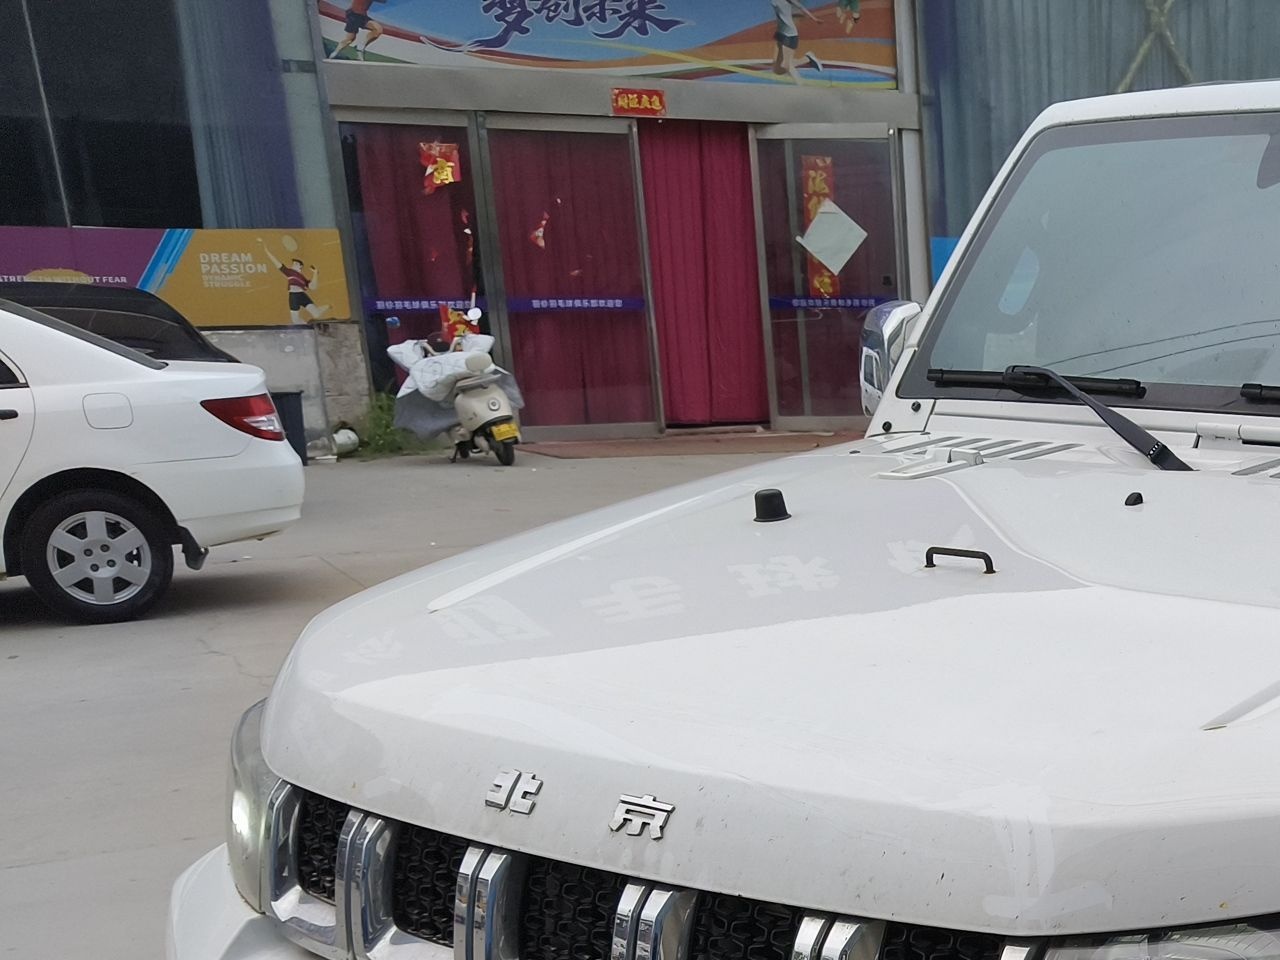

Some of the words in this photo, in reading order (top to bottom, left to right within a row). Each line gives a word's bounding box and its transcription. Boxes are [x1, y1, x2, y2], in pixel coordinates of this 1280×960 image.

[200, 253, 253, 263] DREAM
[201, 264, 268, 273] PASSION
[102, 276, 128, 284] FEAR
[485, 769, 675, 840] 北京
